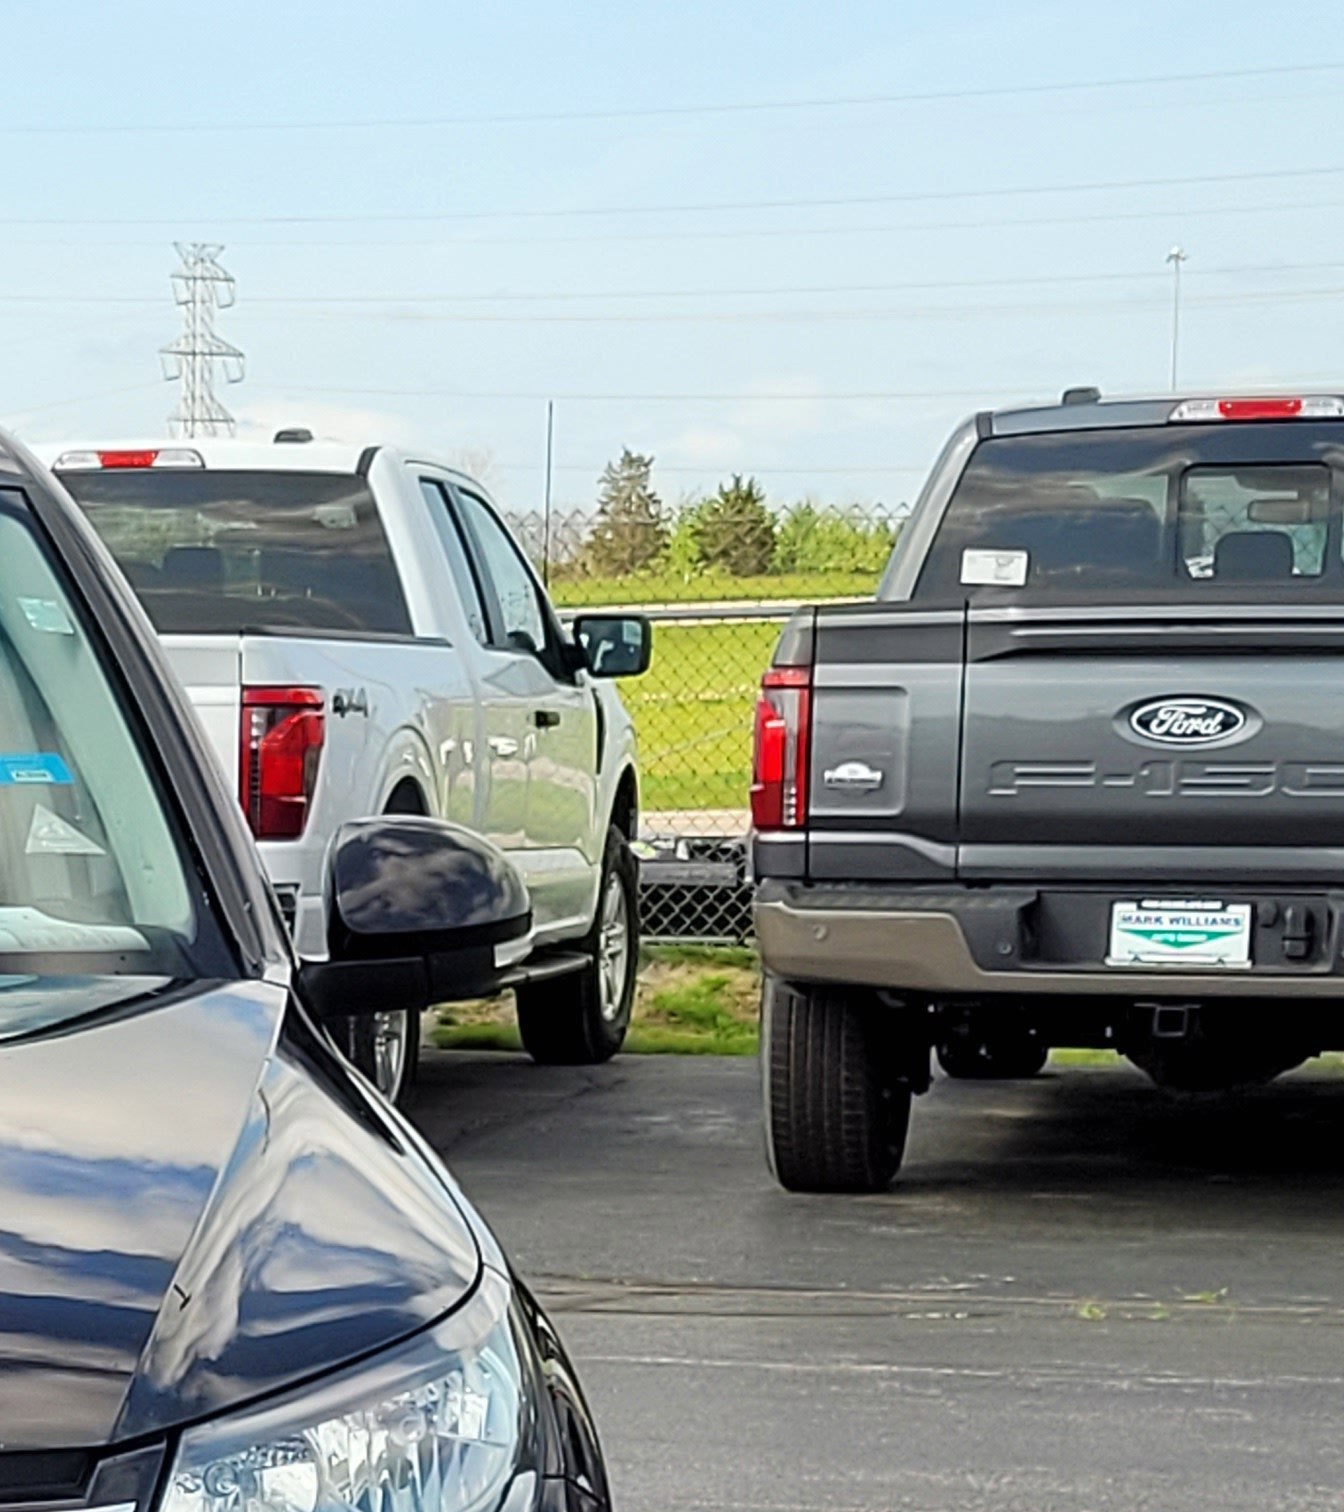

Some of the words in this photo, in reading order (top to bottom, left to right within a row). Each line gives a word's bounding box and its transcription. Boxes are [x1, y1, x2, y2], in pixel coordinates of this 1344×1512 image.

[1149, 705, 1225, 735] Ford
[1121, 914, 1163, 925] MARK
[1169, 916, 1242, 927] WILLIAMS
